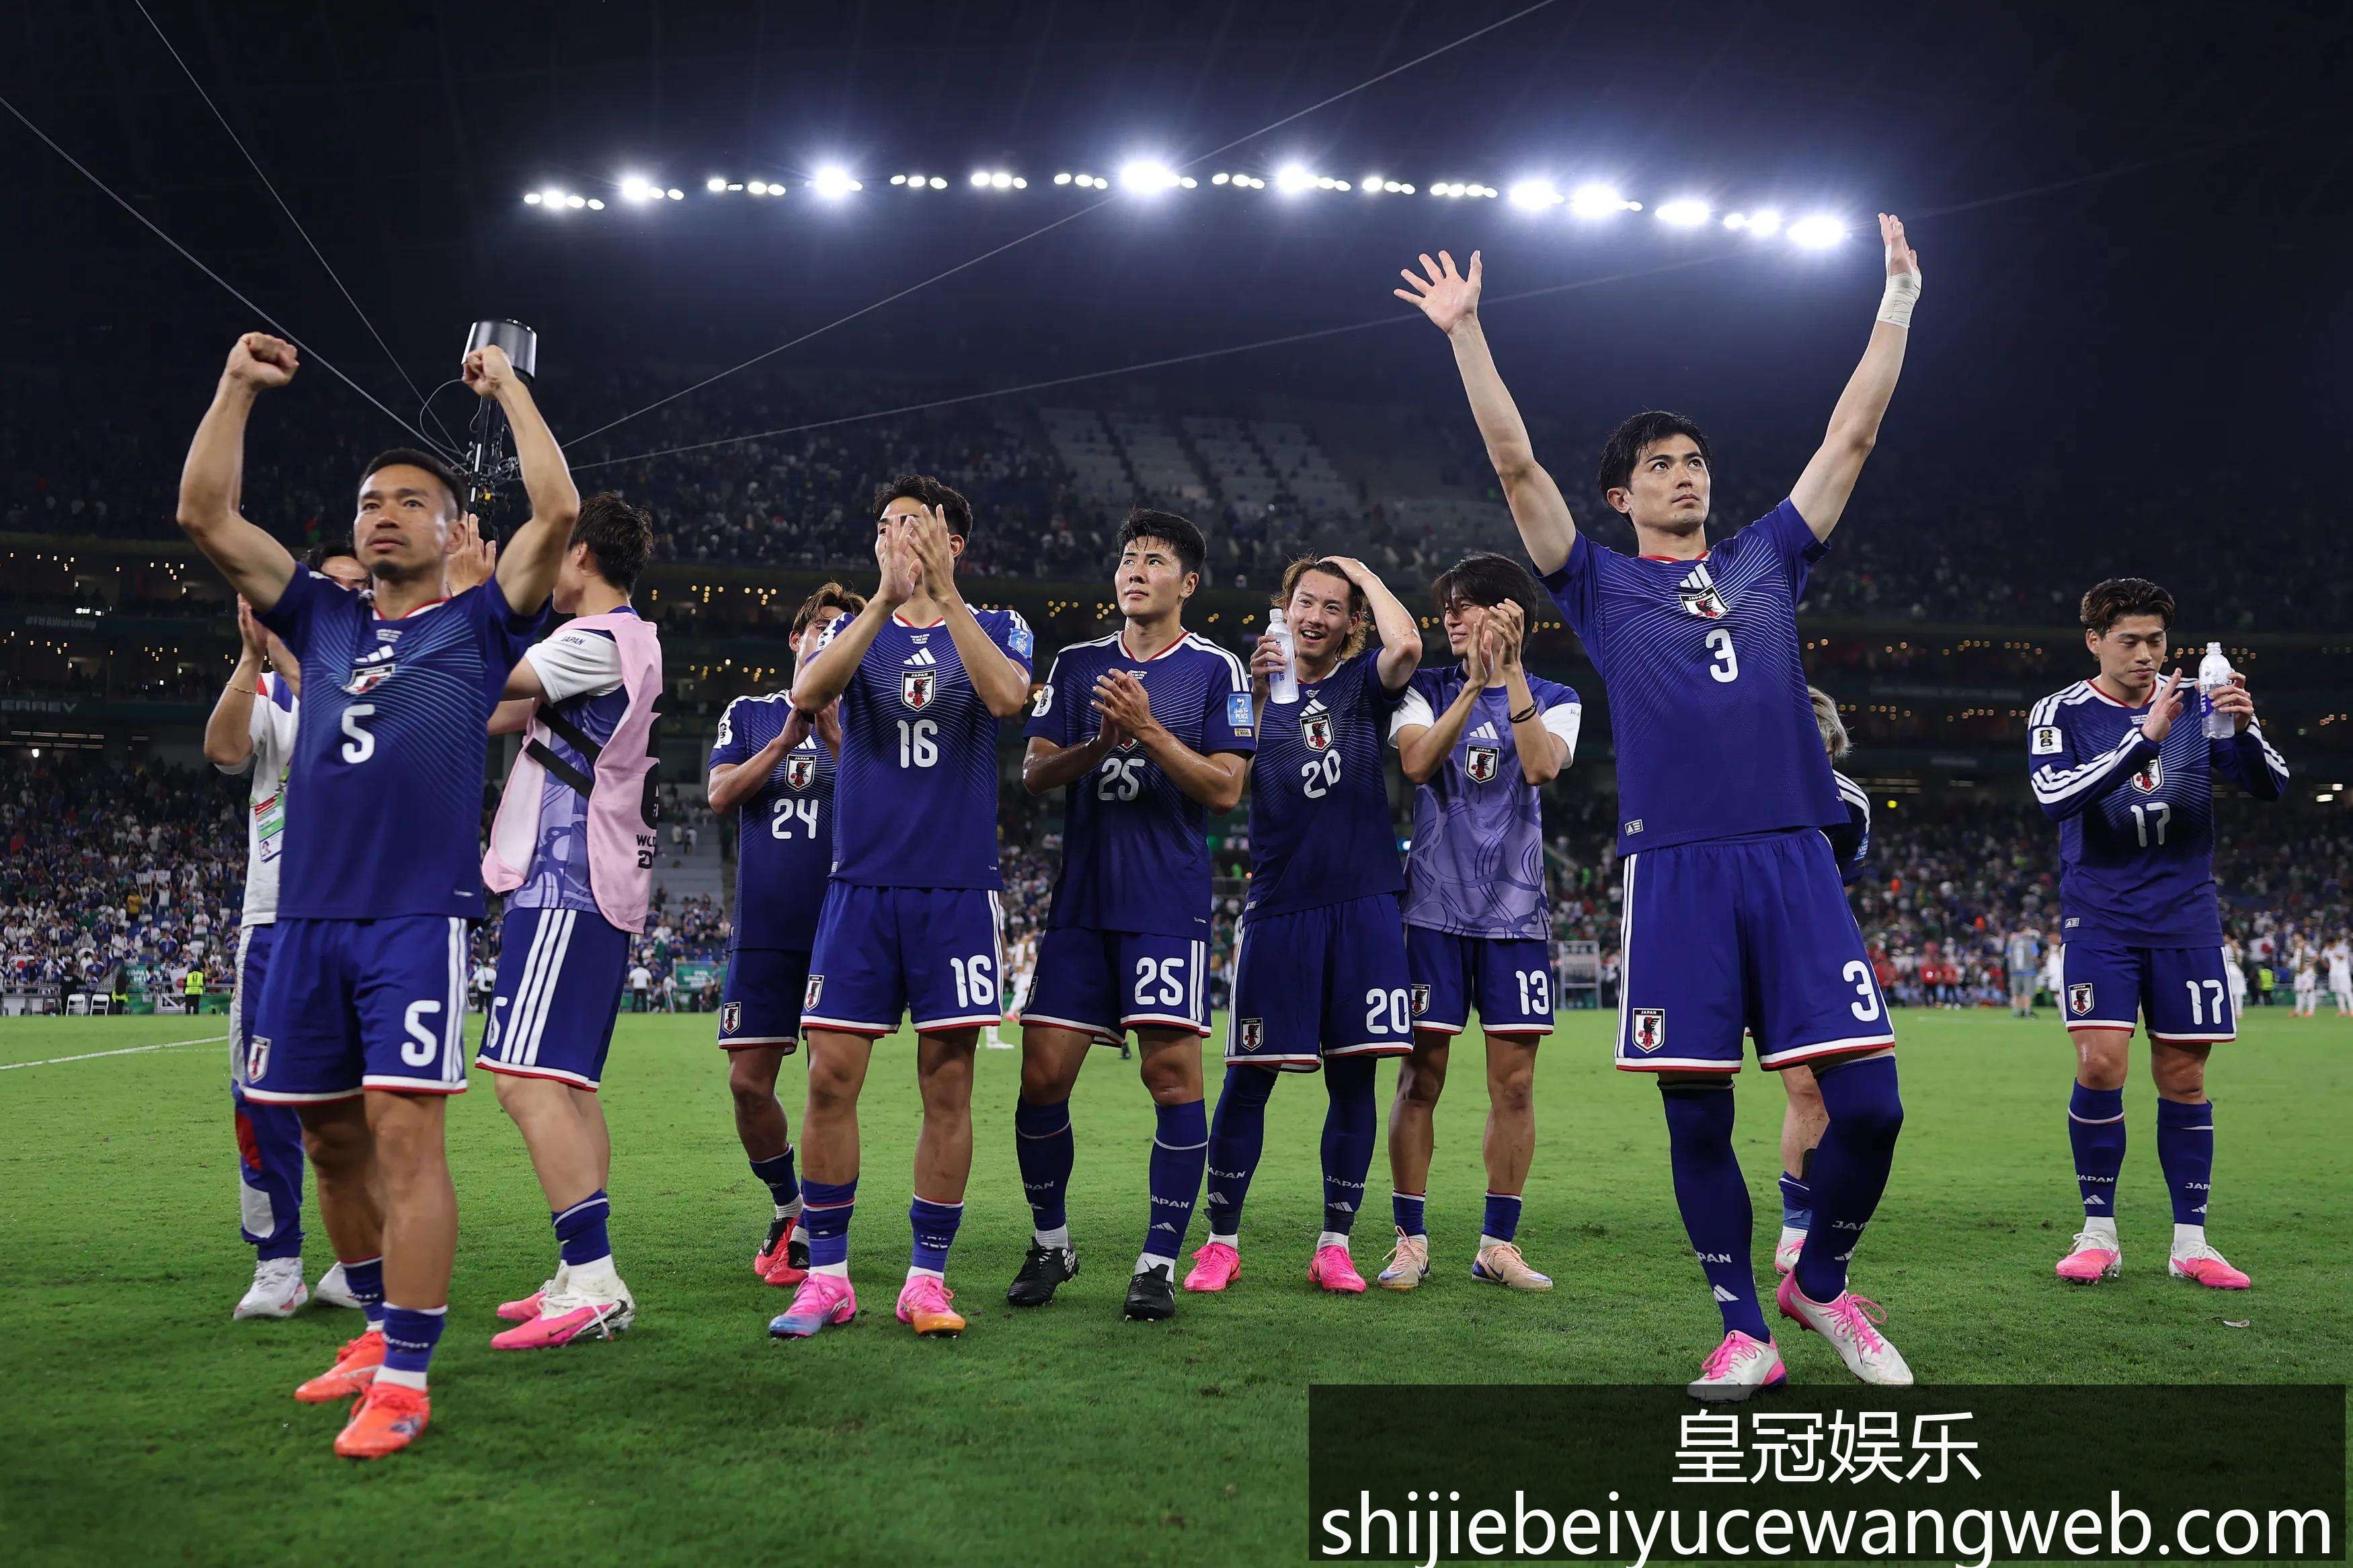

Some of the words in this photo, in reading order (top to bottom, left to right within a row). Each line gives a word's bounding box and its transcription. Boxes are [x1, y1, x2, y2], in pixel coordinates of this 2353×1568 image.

[1688, 592, 1707, 600] JAPAN
[1706, 628, 1738, 683] 3
[342, 704, 376, 764] 5
[897, 719, 939, 768] 16
[1098, 757, 1146, 800] 25
[1302, 749, 1341, 798] 20
[772, 798, 819, 839] 24
[2130, 802, 2171, 847] 17
[950, 954, 994, 1007] 16
[1134, 957, 1185, 1006] 25
[1515, 970, 1550, 1015] 13
[1843, 960, 1880, 1022] 3
[2186, 979, 2225, 1025] 17
[401, 1000, 441, 1067] 5
[1366, 988, 1410, 1034] 20
[1025, 1181, 1054, 1190] PAN
[1207, 1164, 1246, 1179] APAN
[2185, 1182, 2210, 1190] JAP
[1831, 1221, 1868, 1231] JAP
[1695, 1251, 1732, 1264] PAN
